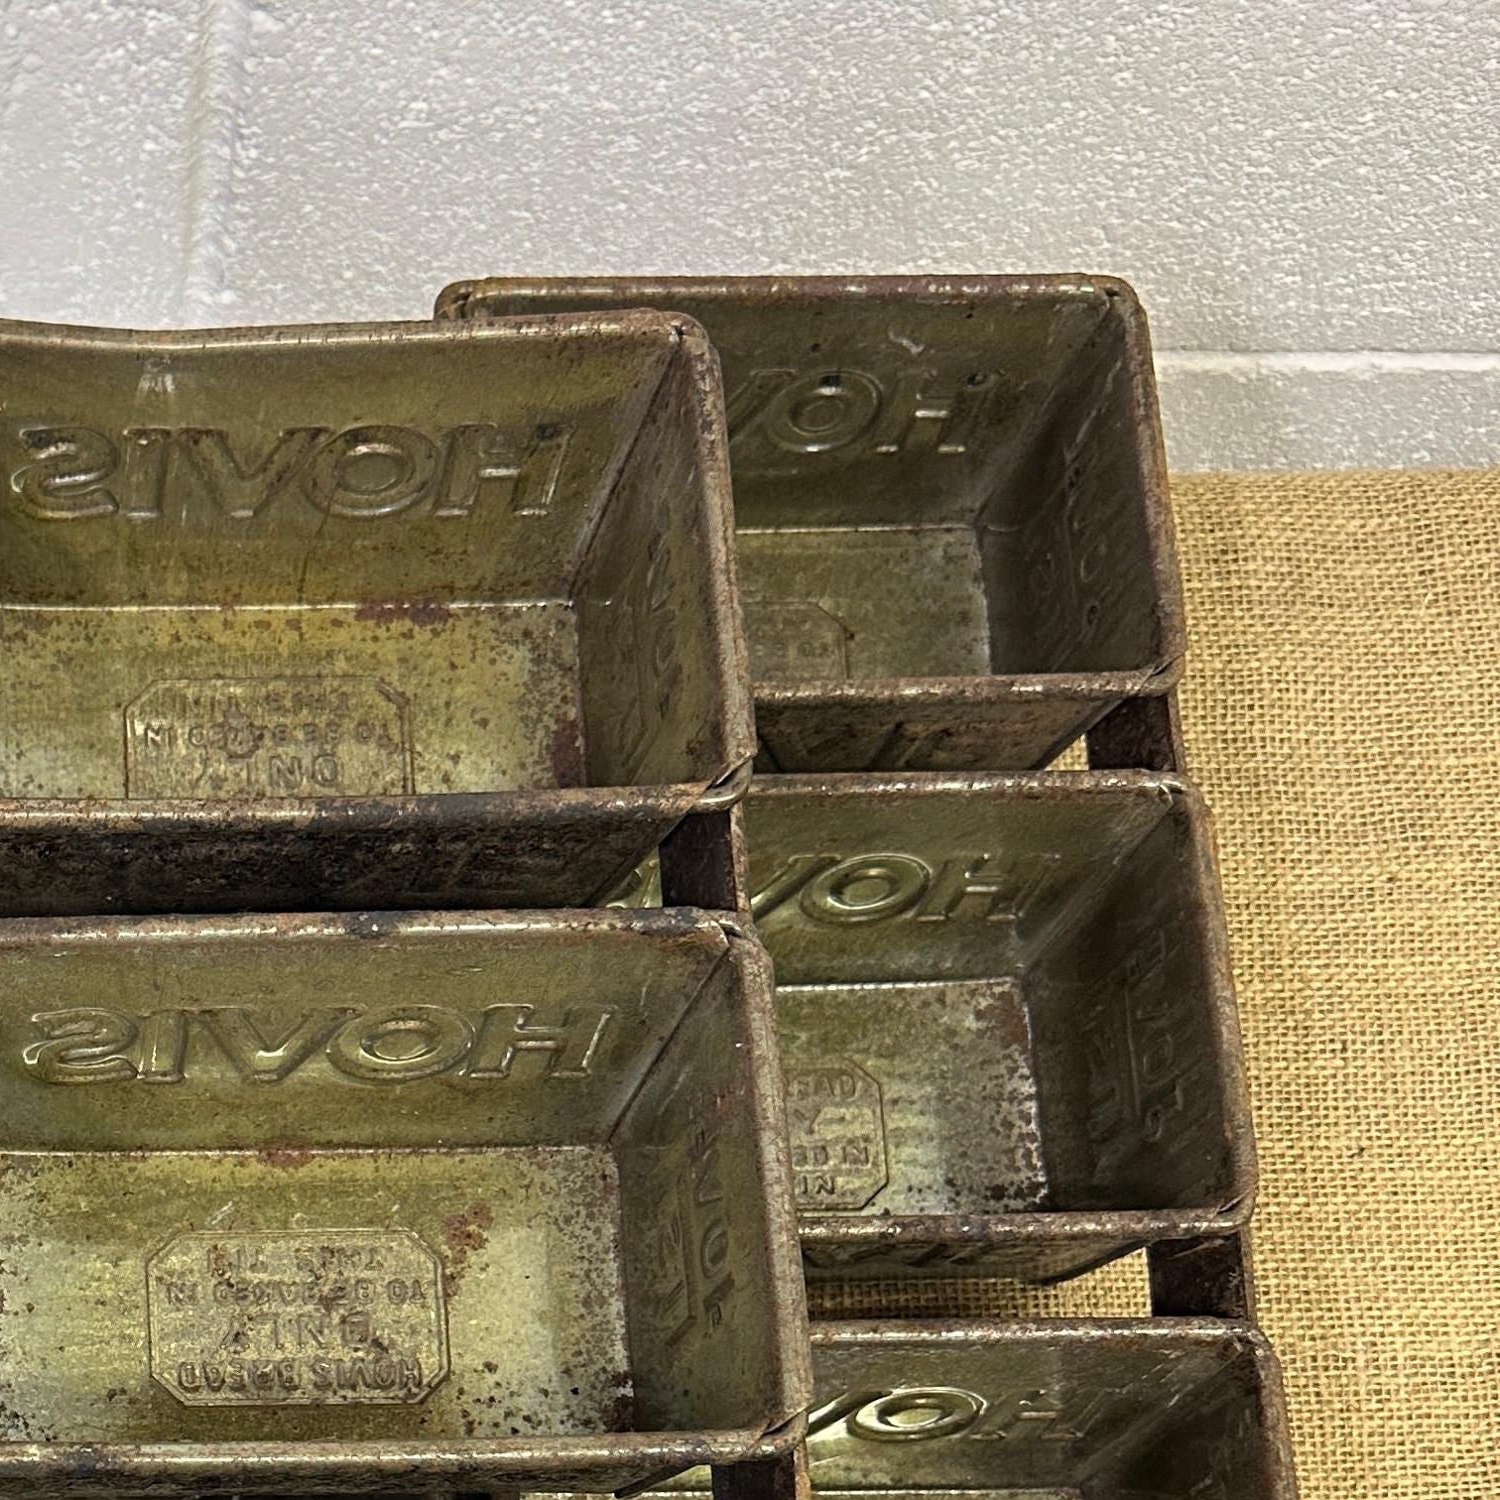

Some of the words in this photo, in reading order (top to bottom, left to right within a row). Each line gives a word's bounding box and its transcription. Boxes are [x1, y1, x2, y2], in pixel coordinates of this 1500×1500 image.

[218, 1311, 372, 1352] ONLY
[176, 1359, 301, 1395] BREAD
[308, 1358, 423, 1395] HOVIS
